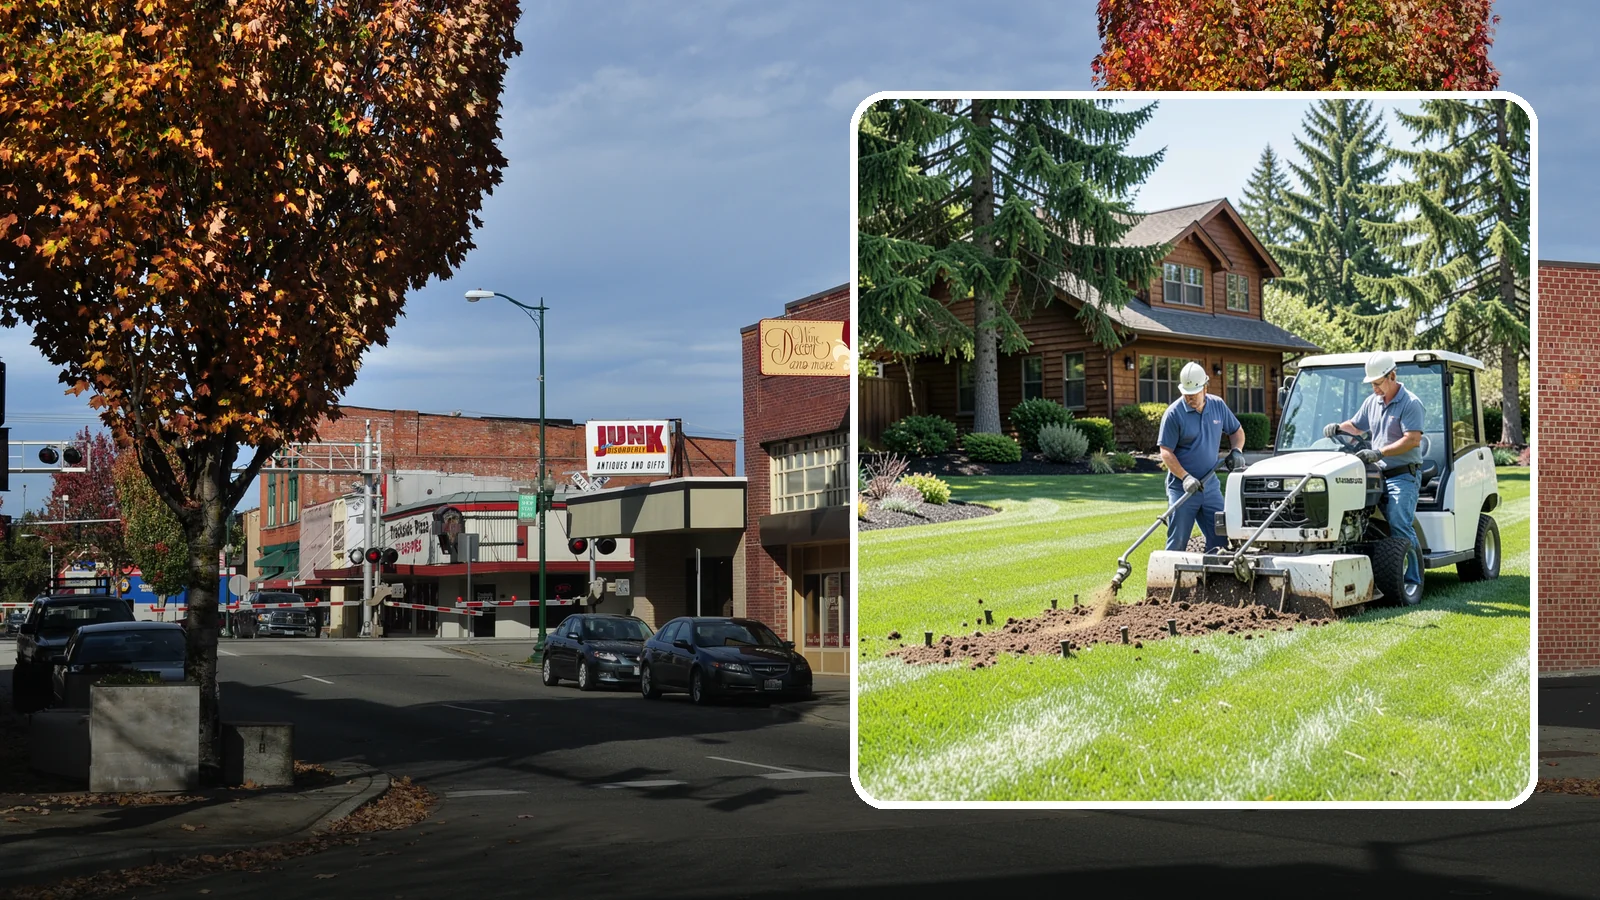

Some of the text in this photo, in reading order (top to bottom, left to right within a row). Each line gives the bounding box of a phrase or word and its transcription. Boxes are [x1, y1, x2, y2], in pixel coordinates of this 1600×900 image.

[765, 328, 831, 365] Decor
[596, 425, 665, 457] JUNK
[607, 446, 646, 454] DISORDERLY
[597, 461, 665, 470] ANTIQUES AND GIFTS
